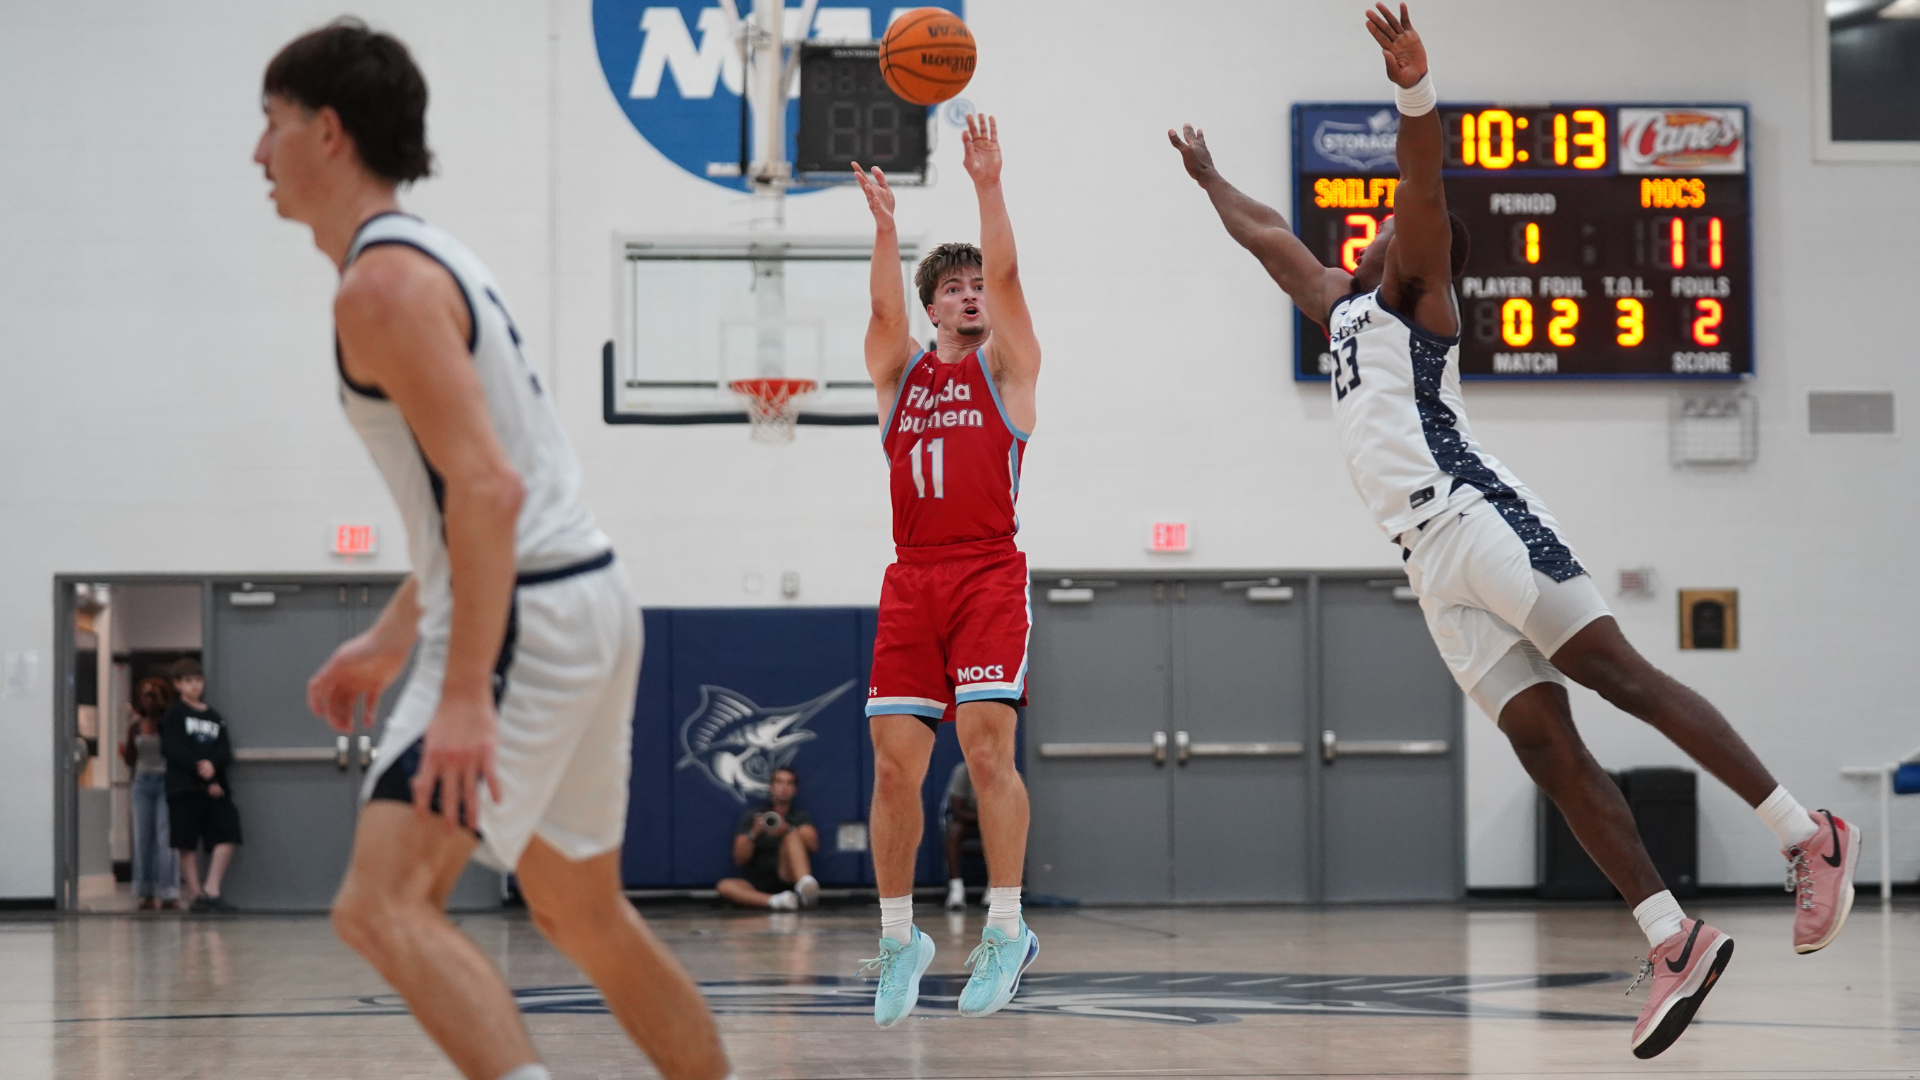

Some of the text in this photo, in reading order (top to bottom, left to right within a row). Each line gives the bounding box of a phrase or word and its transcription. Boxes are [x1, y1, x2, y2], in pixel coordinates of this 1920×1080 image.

[921, 53, 975, 73] Wilson
[1462, 109, 1606, 169] 10:13
[1490, 193, 1557, 215] PERIOD
[1641, 178, 1705, 208] MOCS
[1525, 222, 1539, 264] 1
[1670, 216, 1722, 269] 11
[1463, 277, 1587, 298] PLAYER FOUL
[1671, 276, 1731, 298] FOULS
[1548, 298, 1578, 346] 2
[1616, 298, 1643, 346] 3
[1692, 298, 1722, 346] 2
[1493, 352, 1558, 374] MATCH
[1671, 352, 1731, 373] SCORE
[909, 437, 944, 499] 11
[336, 524, 372, 553] EXIT
[1152, 522, 1188, 551] EXIT
[957, 665, 1004, 683] MOCS
